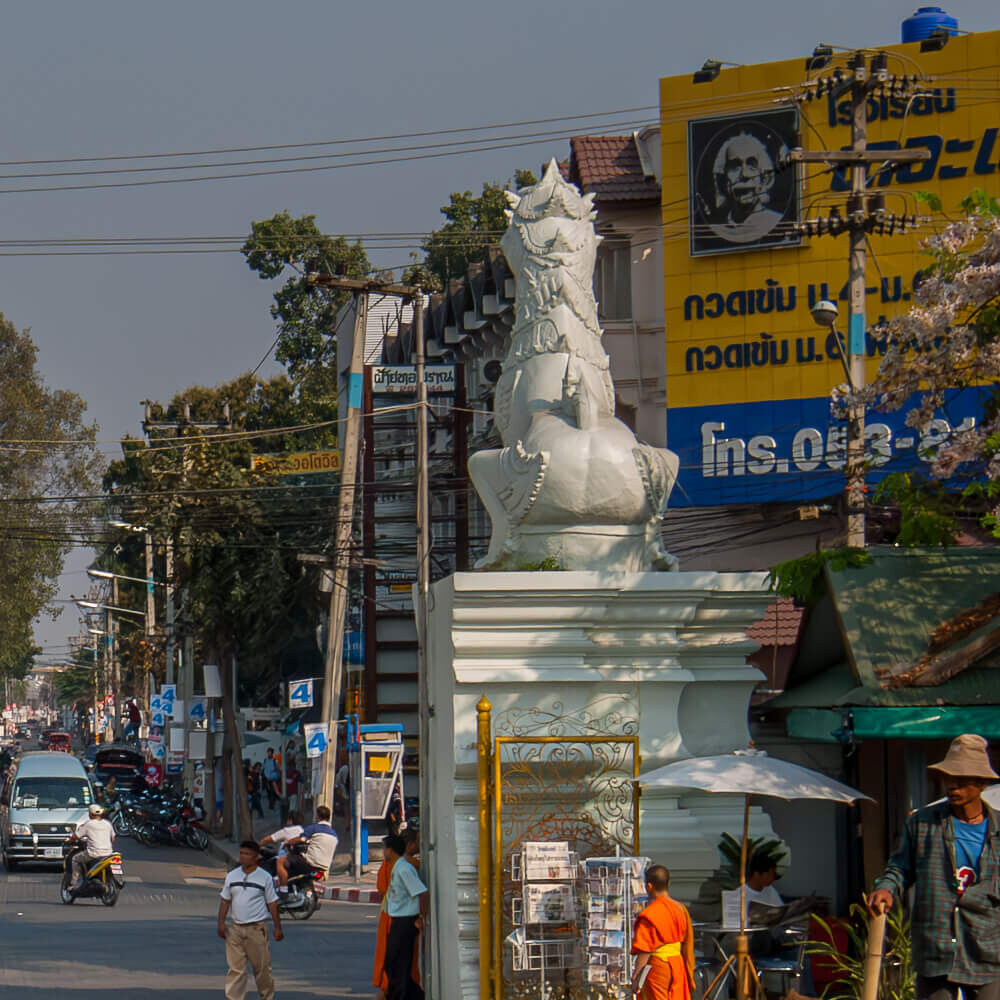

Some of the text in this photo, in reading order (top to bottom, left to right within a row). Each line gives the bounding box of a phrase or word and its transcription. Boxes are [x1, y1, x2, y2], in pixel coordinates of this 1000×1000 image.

[162, 689, 175, 701] 4
[291, 684, 311, 703] 4
[151, 698, 161, 709] 4
[190, 703, 205, 718] 4
[152, 715, 163, 724] 4
[307, 732, 328, 753] 4
